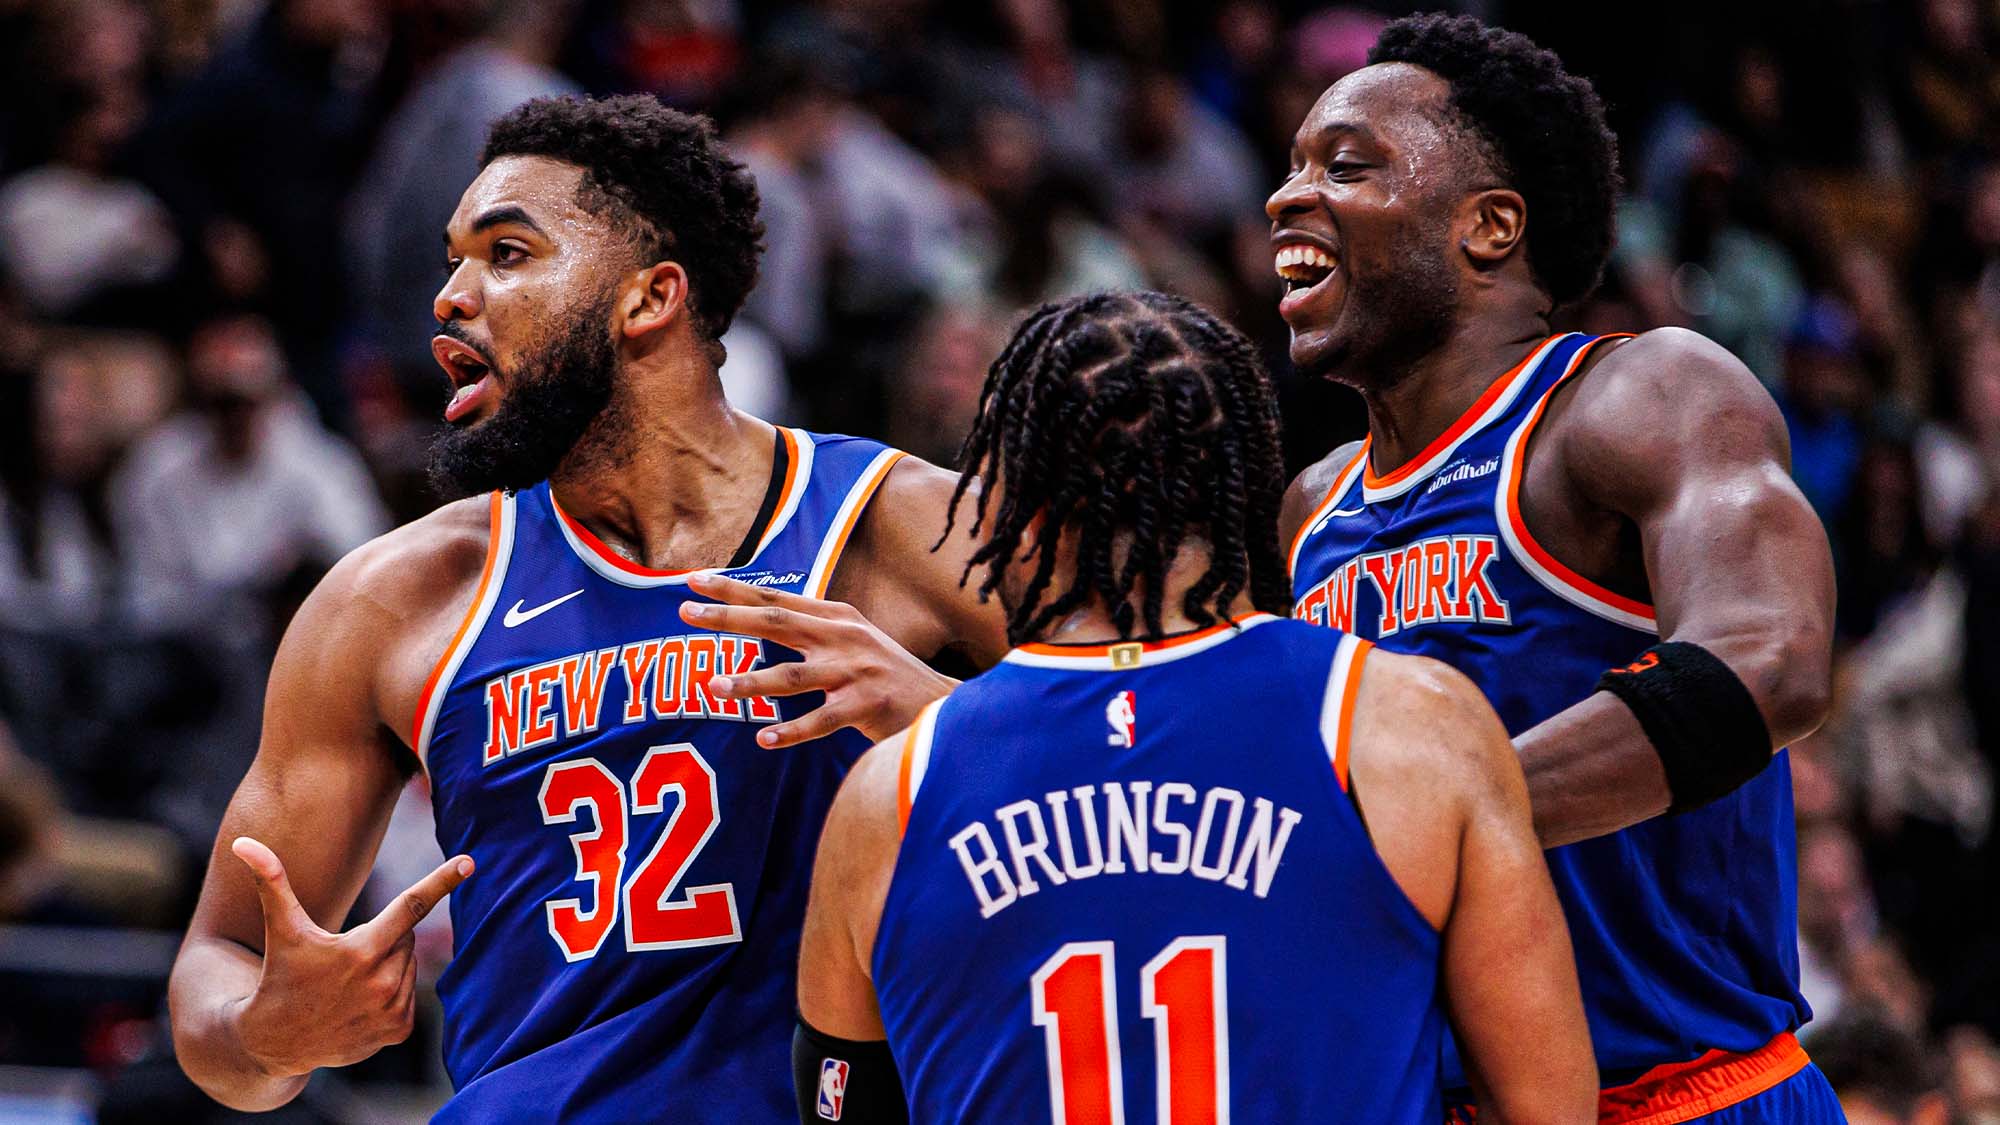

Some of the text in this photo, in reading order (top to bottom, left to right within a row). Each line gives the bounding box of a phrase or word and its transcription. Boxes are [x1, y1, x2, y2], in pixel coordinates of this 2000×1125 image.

[1360, 534, 1512, 640] YORK
[482, 633, 782, 767] NEW YORK
[537, 743, 743, 963] 32
[948, 780, 1303, 920] BRUNSON
[1030, 935, 1231, 1125] 11
